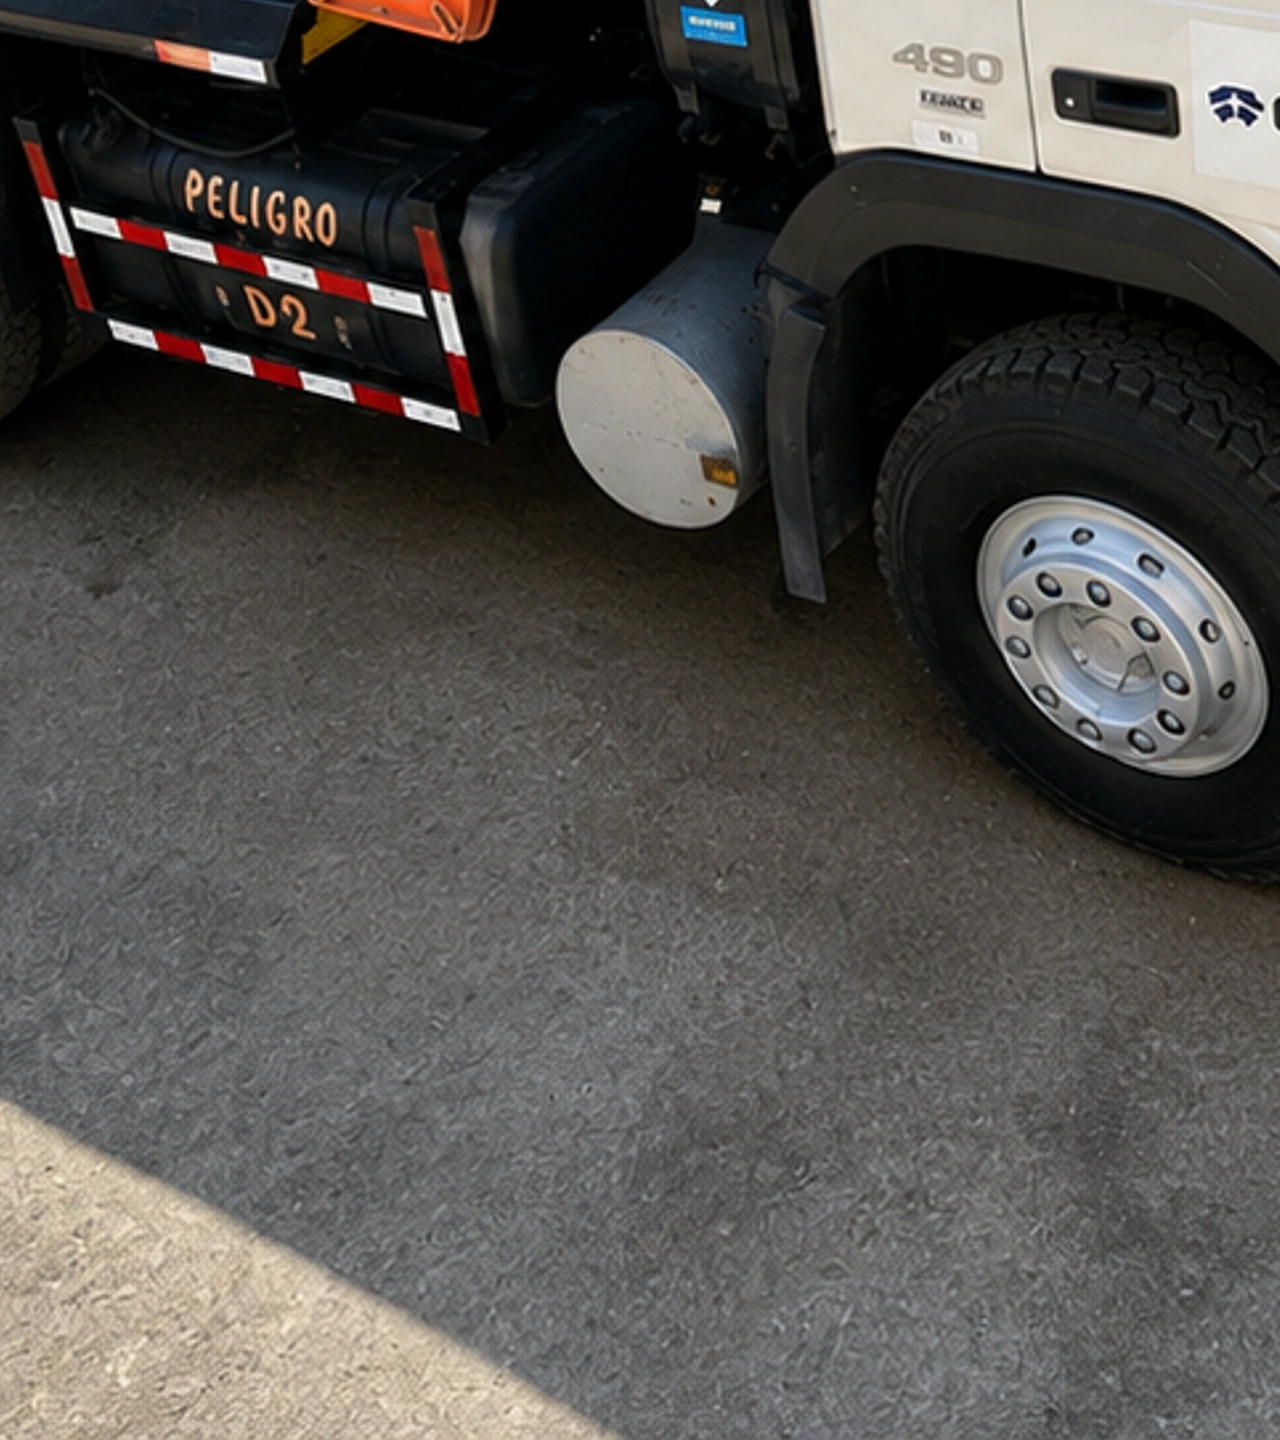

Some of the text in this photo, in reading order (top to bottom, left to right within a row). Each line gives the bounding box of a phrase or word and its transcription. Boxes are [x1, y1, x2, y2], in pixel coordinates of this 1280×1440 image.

[892, 42, 1005, 86] 490
[184, 168, 338, 248] PELIGRO
[242, 284, 317, 341] D2
